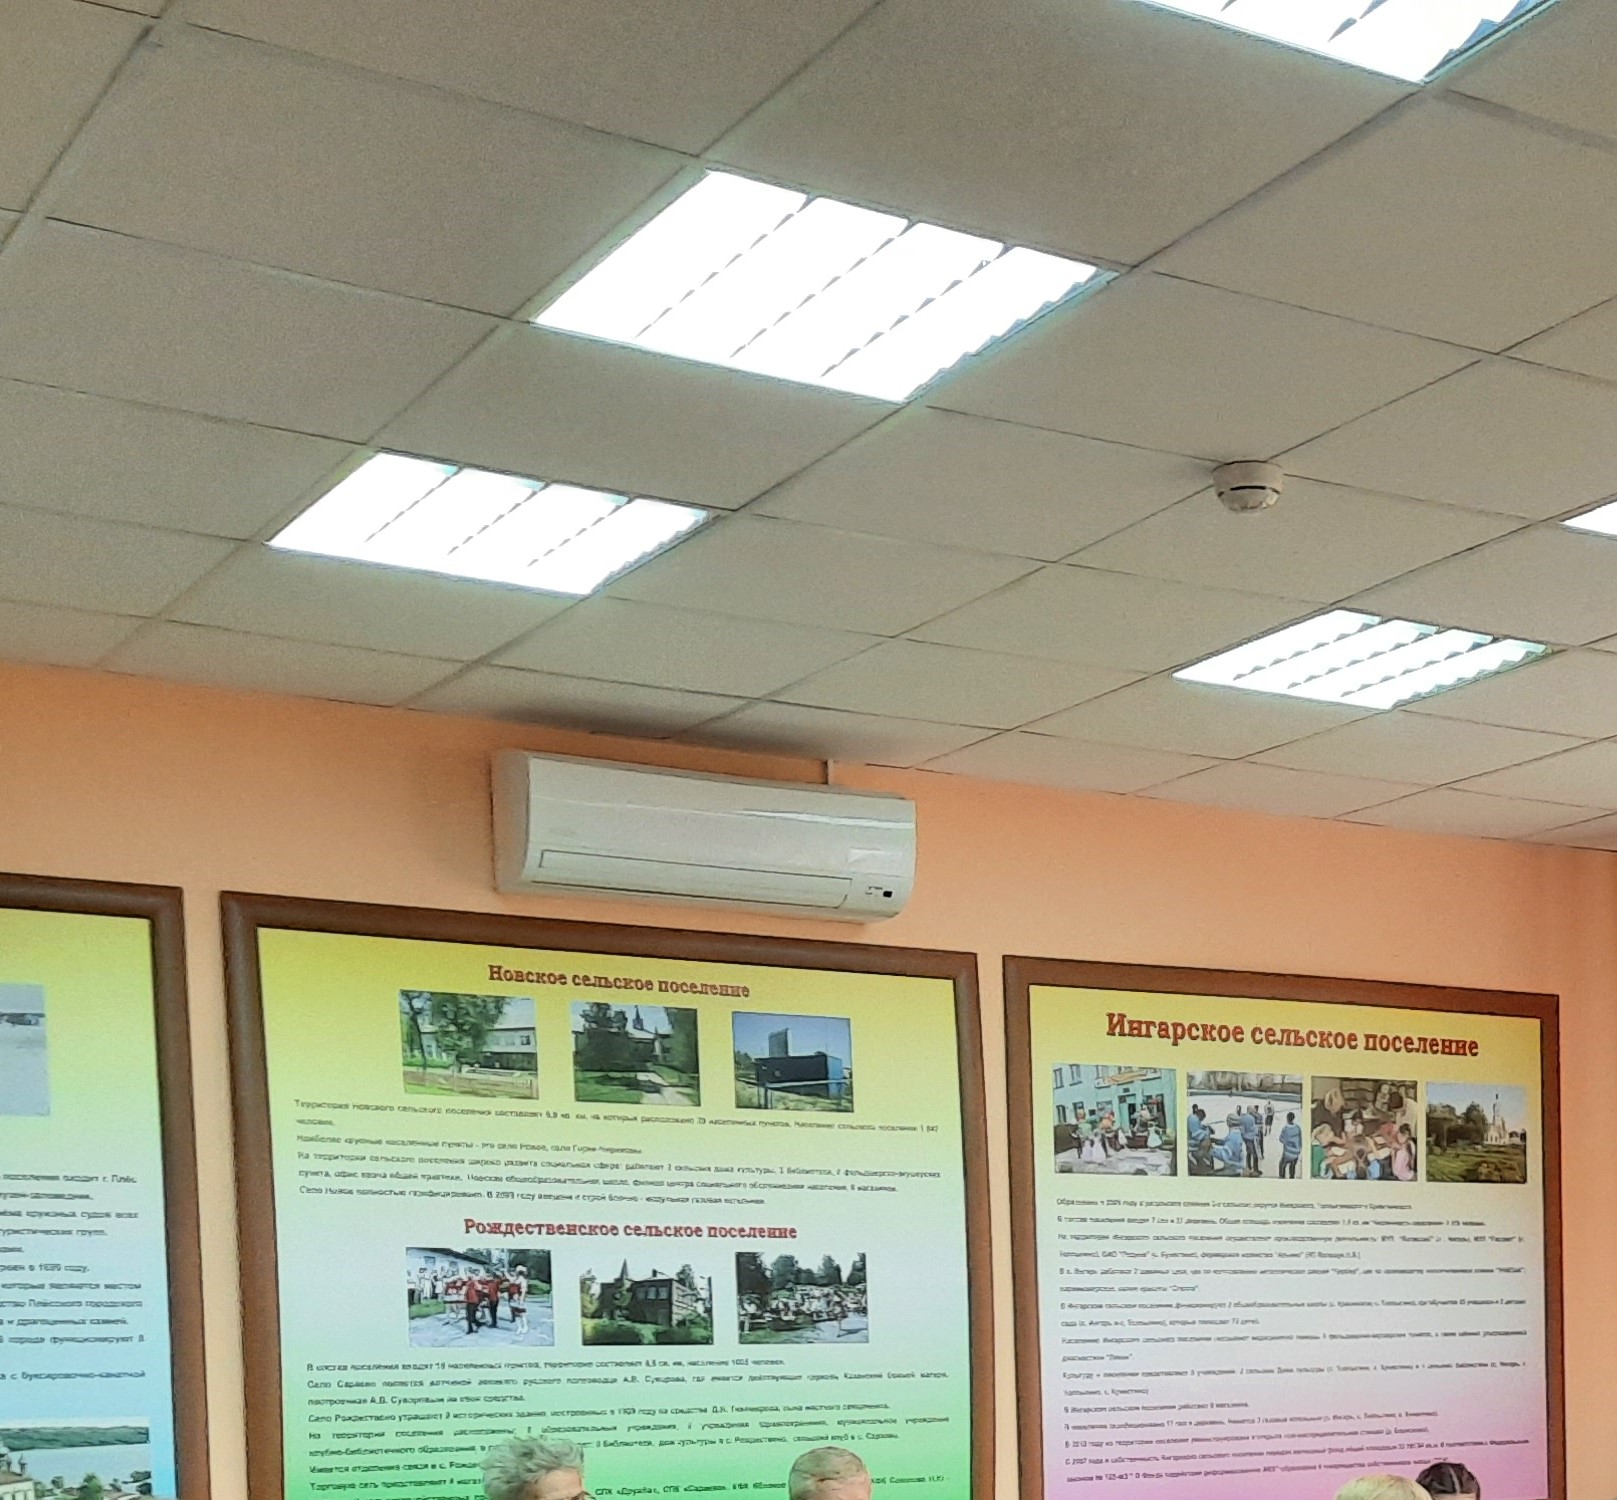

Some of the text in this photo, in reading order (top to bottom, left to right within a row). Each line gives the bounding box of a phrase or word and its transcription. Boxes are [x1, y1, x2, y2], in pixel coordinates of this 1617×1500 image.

[488, 964, 750, 998] Новское сельское поселение
[1104, 1010, 1404, 1046] Ингарское сельское поселение
[463, 1218, 797, 1240] Рождественское сельское поселение
